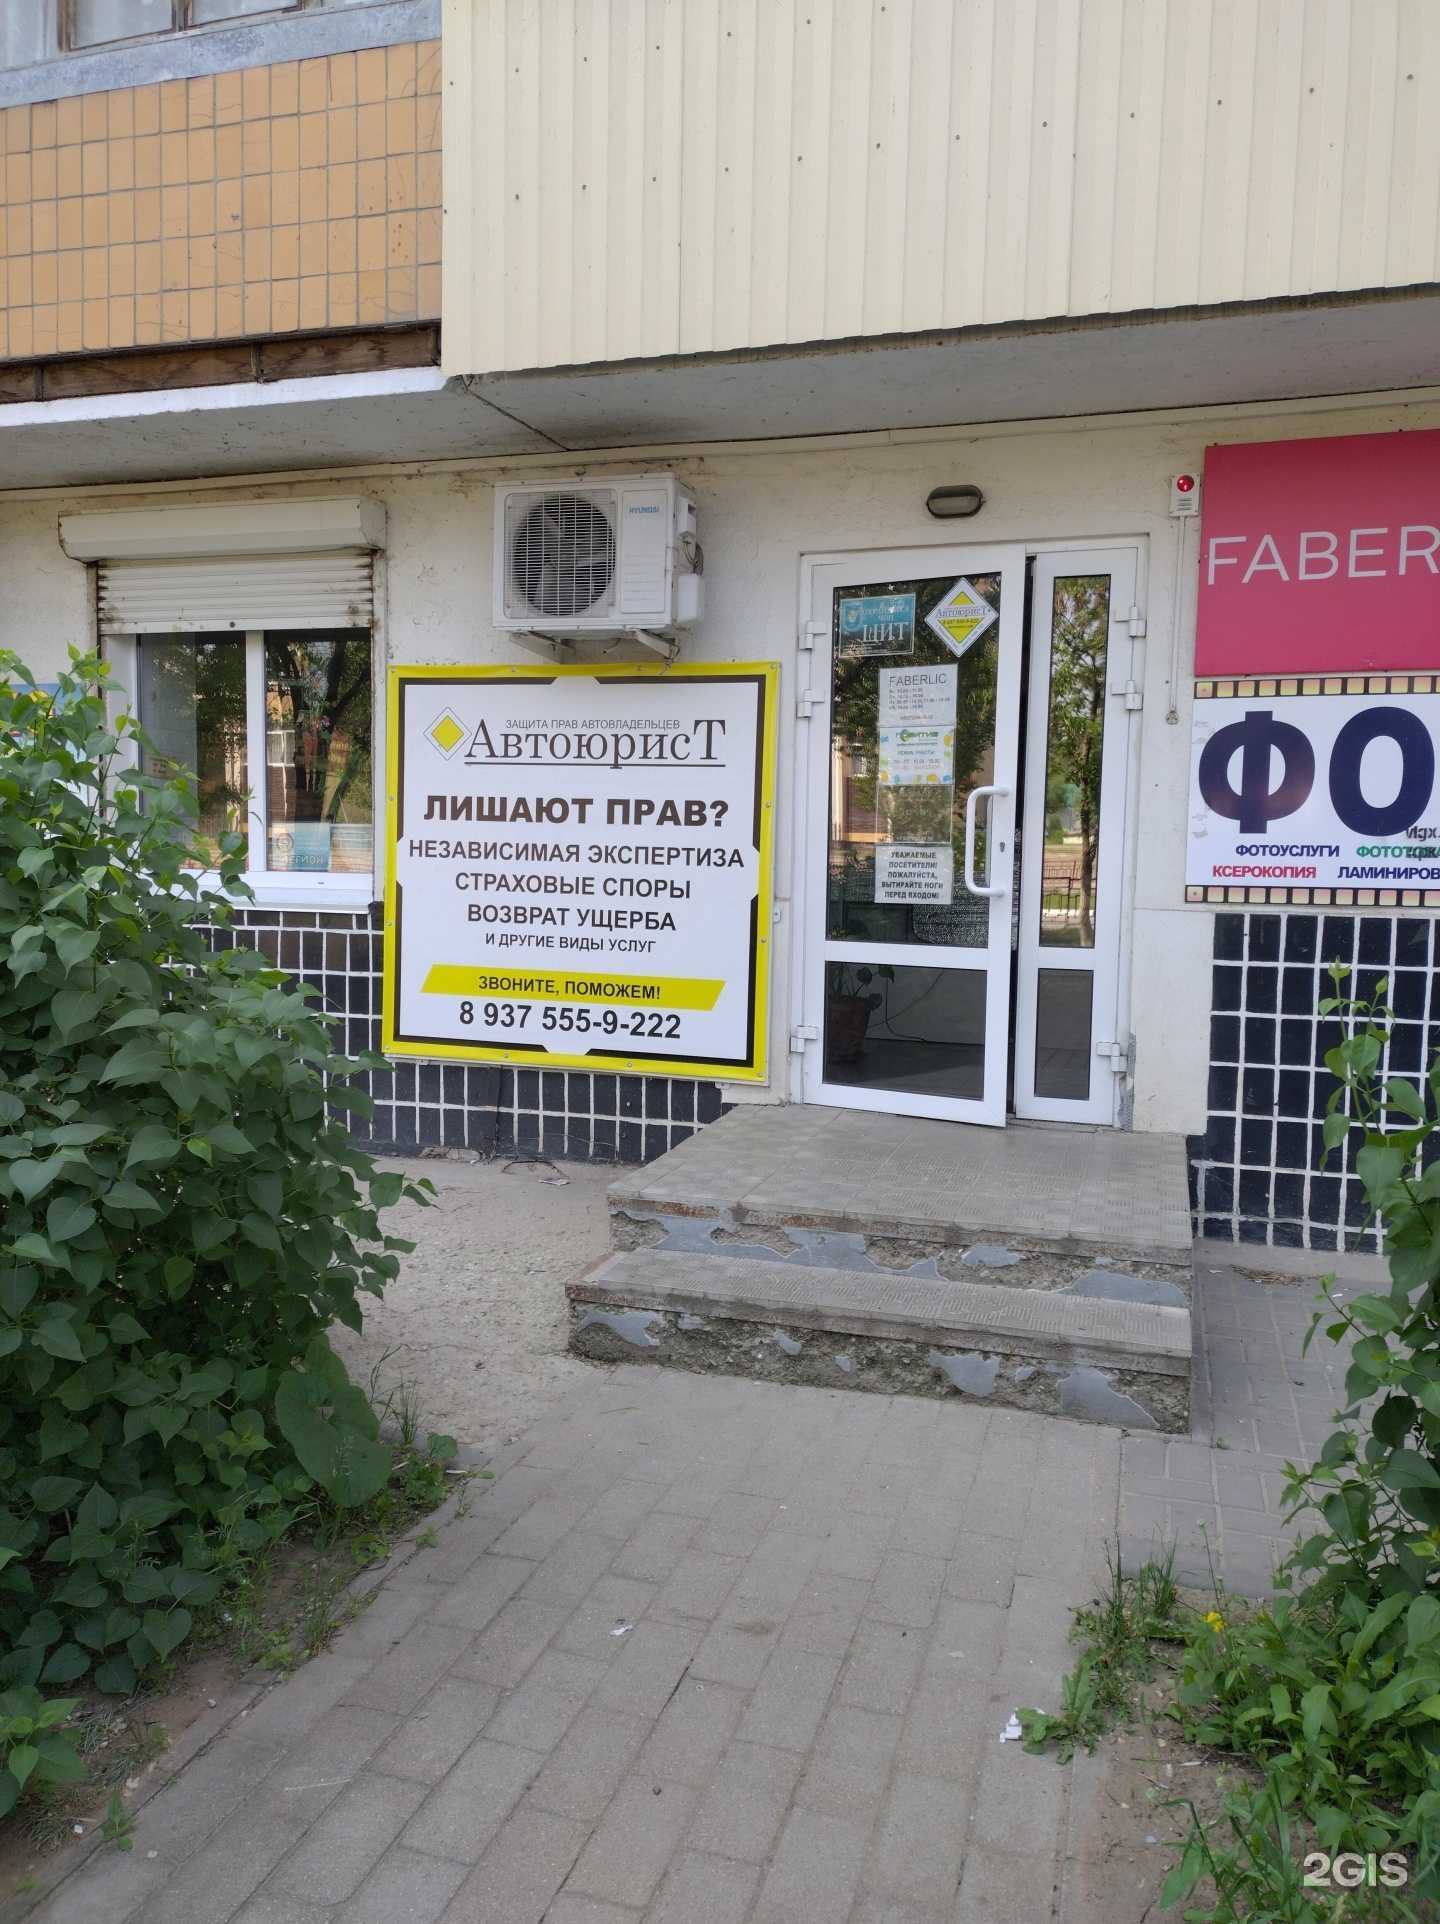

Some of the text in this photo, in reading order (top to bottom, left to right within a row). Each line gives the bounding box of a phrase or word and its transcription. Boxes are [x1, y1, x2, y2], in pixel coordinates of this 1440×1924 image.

[1207, 525, 1440, 585] FABER
[889, 673, 947, 686] FABERLIC
[506, 719, 680, 731] ЗАЩИТА ПРАВ АВТОВЛАДЕЛЬЦЕВ
[464, 719, 726, 769] АвтоюрисТ
[424, 794, 729, 827] ЛИШАЮТ ПРАВ?
[409, 840, 744, 868] НЕЗАВИСИМАЯ ЭКСПЕРТИЗА
[1235, 844, 1340, 857] ФОТОУСЛУГИ
[1213, 865, 1316, 878] КСЕРОКОПИЯ
[455, 872, 691, 899] СТРАХОВЫЕ СПОРЫ
[885, 891, 906, 899] ПЕРЕД
[468, 904, 676, 933] ВОЗВРАТ УЩЕРБА
[485, 933, 656, 953] И ДРУГИЕ ВИДЫ УСЛУГ
[479, 976, 661, 999] ЗВОНИТЕ, ПОМОЖЕМ!
[459, 1001, 681, 1039] 8 937 555-9-222
